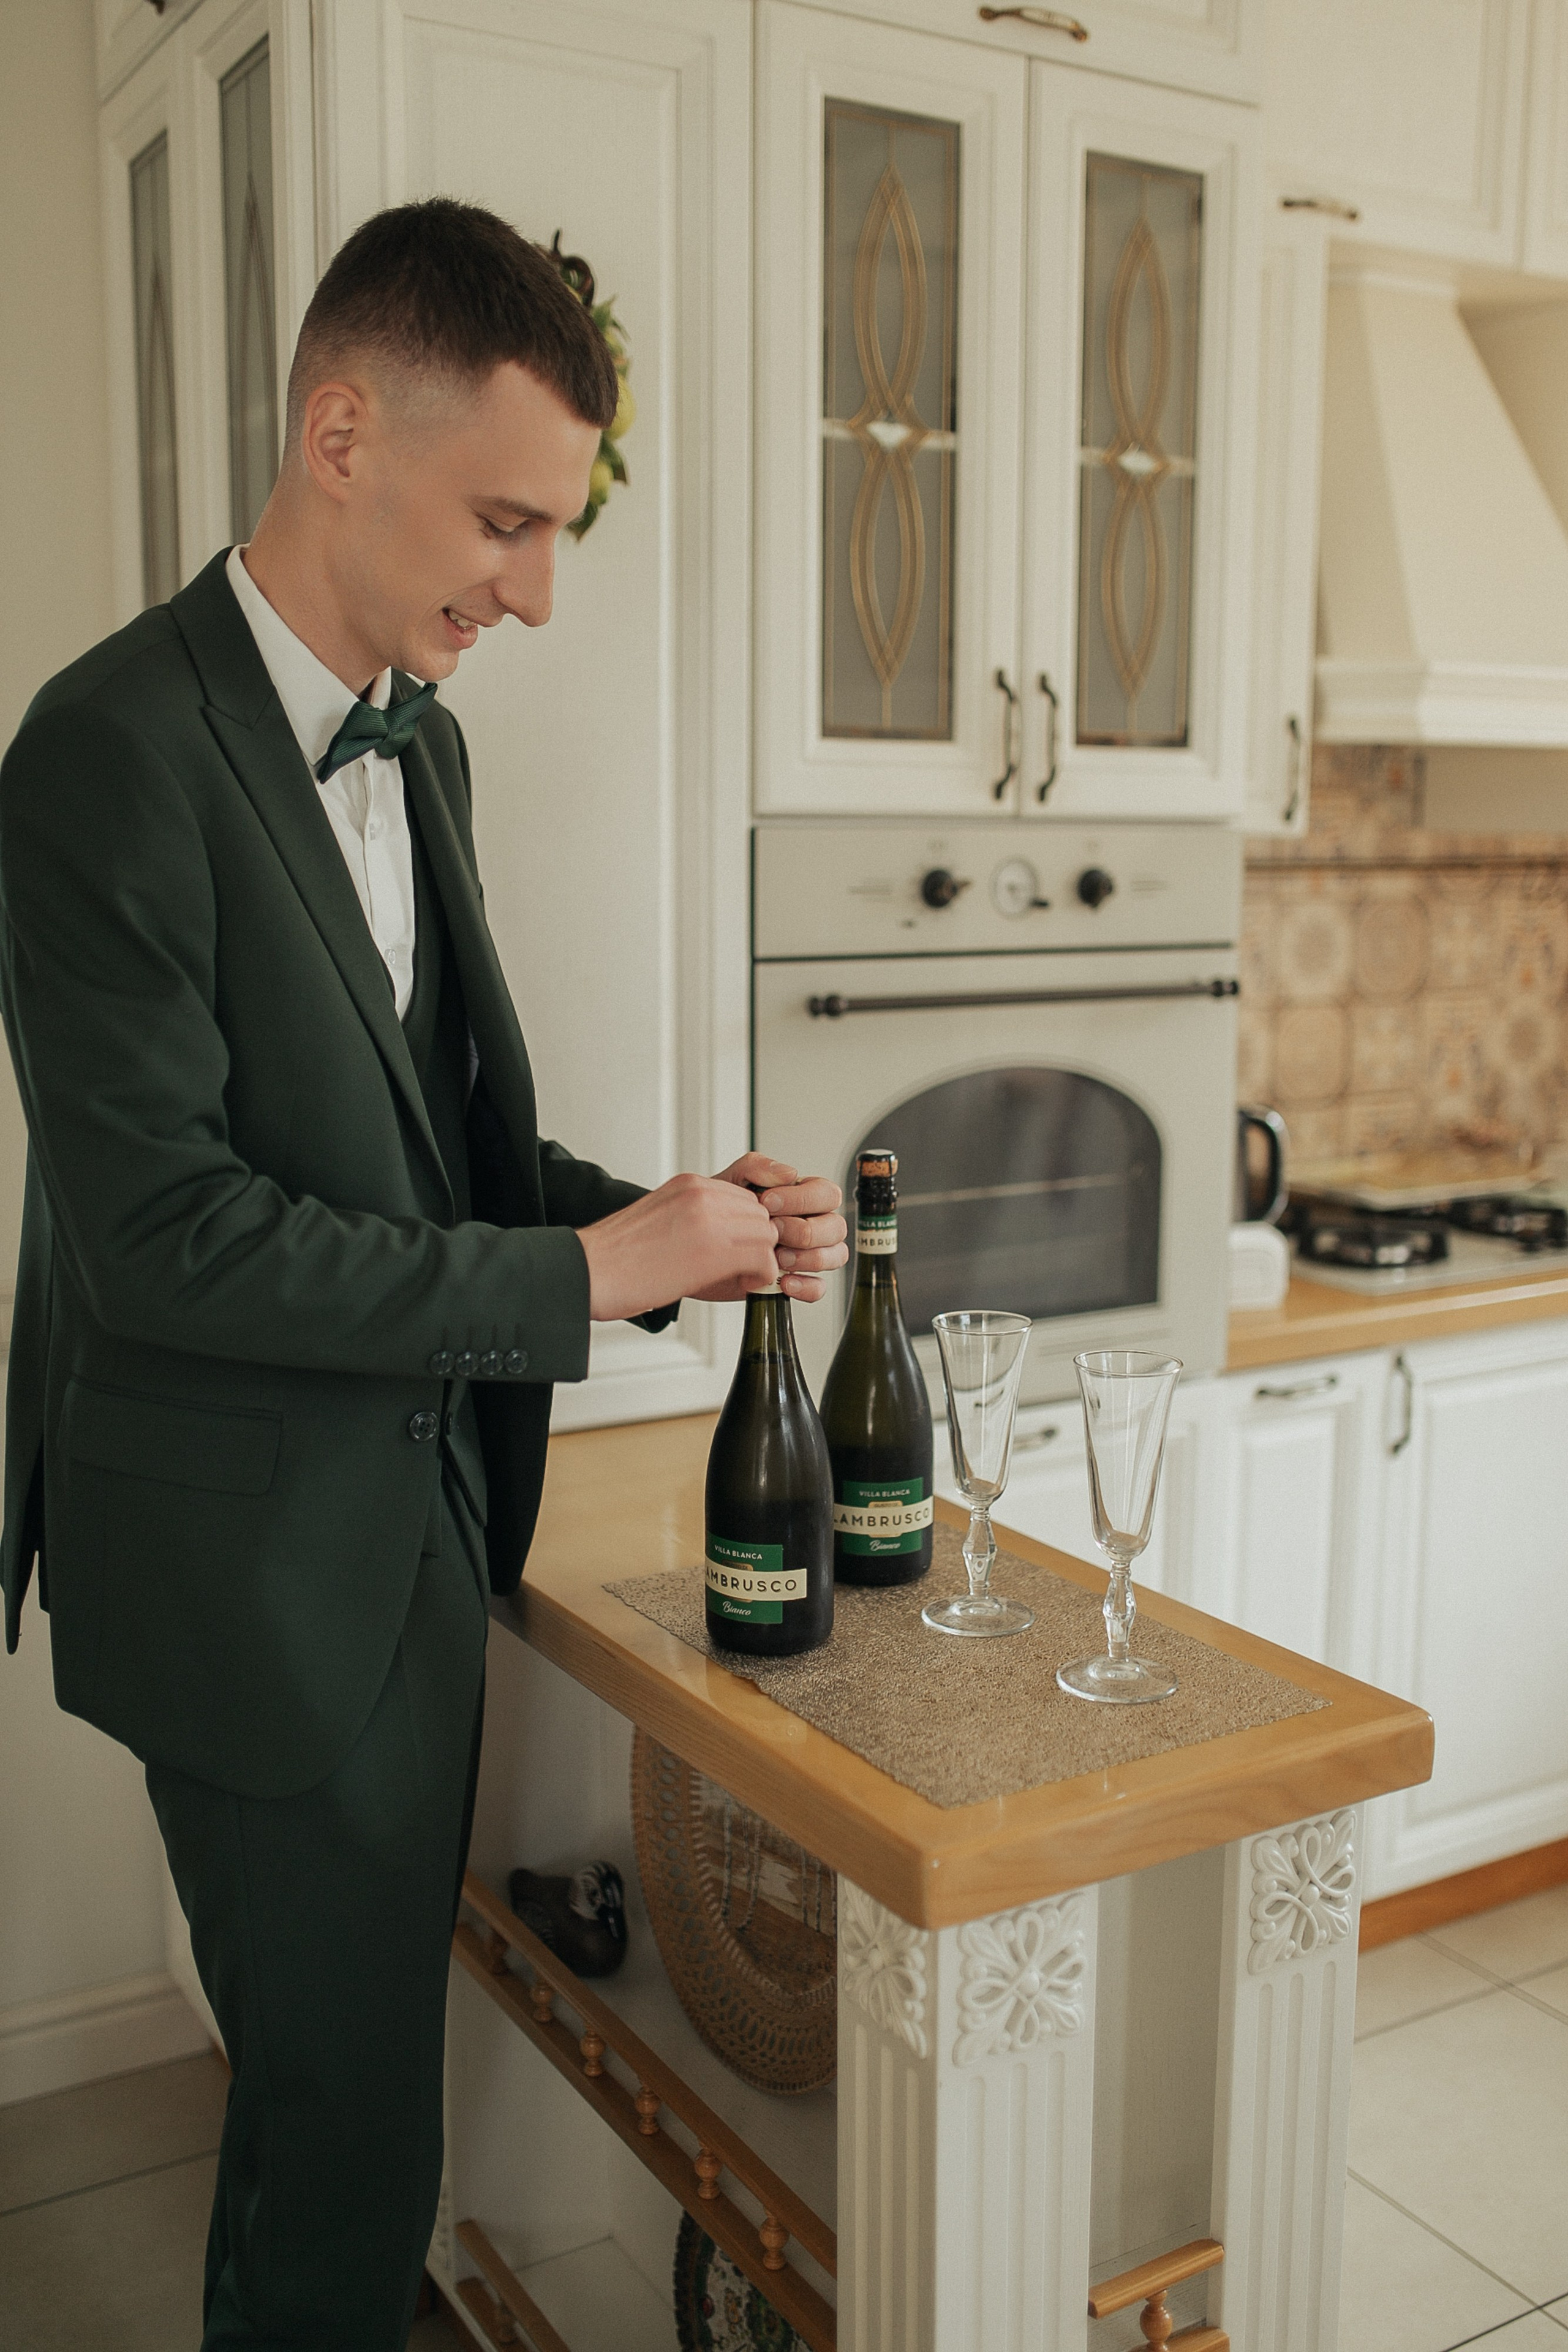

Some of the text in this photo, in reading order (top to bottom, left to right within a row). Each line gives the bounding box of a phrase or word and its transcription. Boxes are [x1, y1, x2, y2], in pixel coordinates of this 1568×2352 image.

[882, 1489, 910, 1498] BLANCA
[714, 1544, 763, 1560] VILLA BLANCA
[869, 1540, 900, 1551] Bianco
[706, 1566, 796, 1593] AMBRUSCO
[723, 1600, 752, 1616] Bianco
